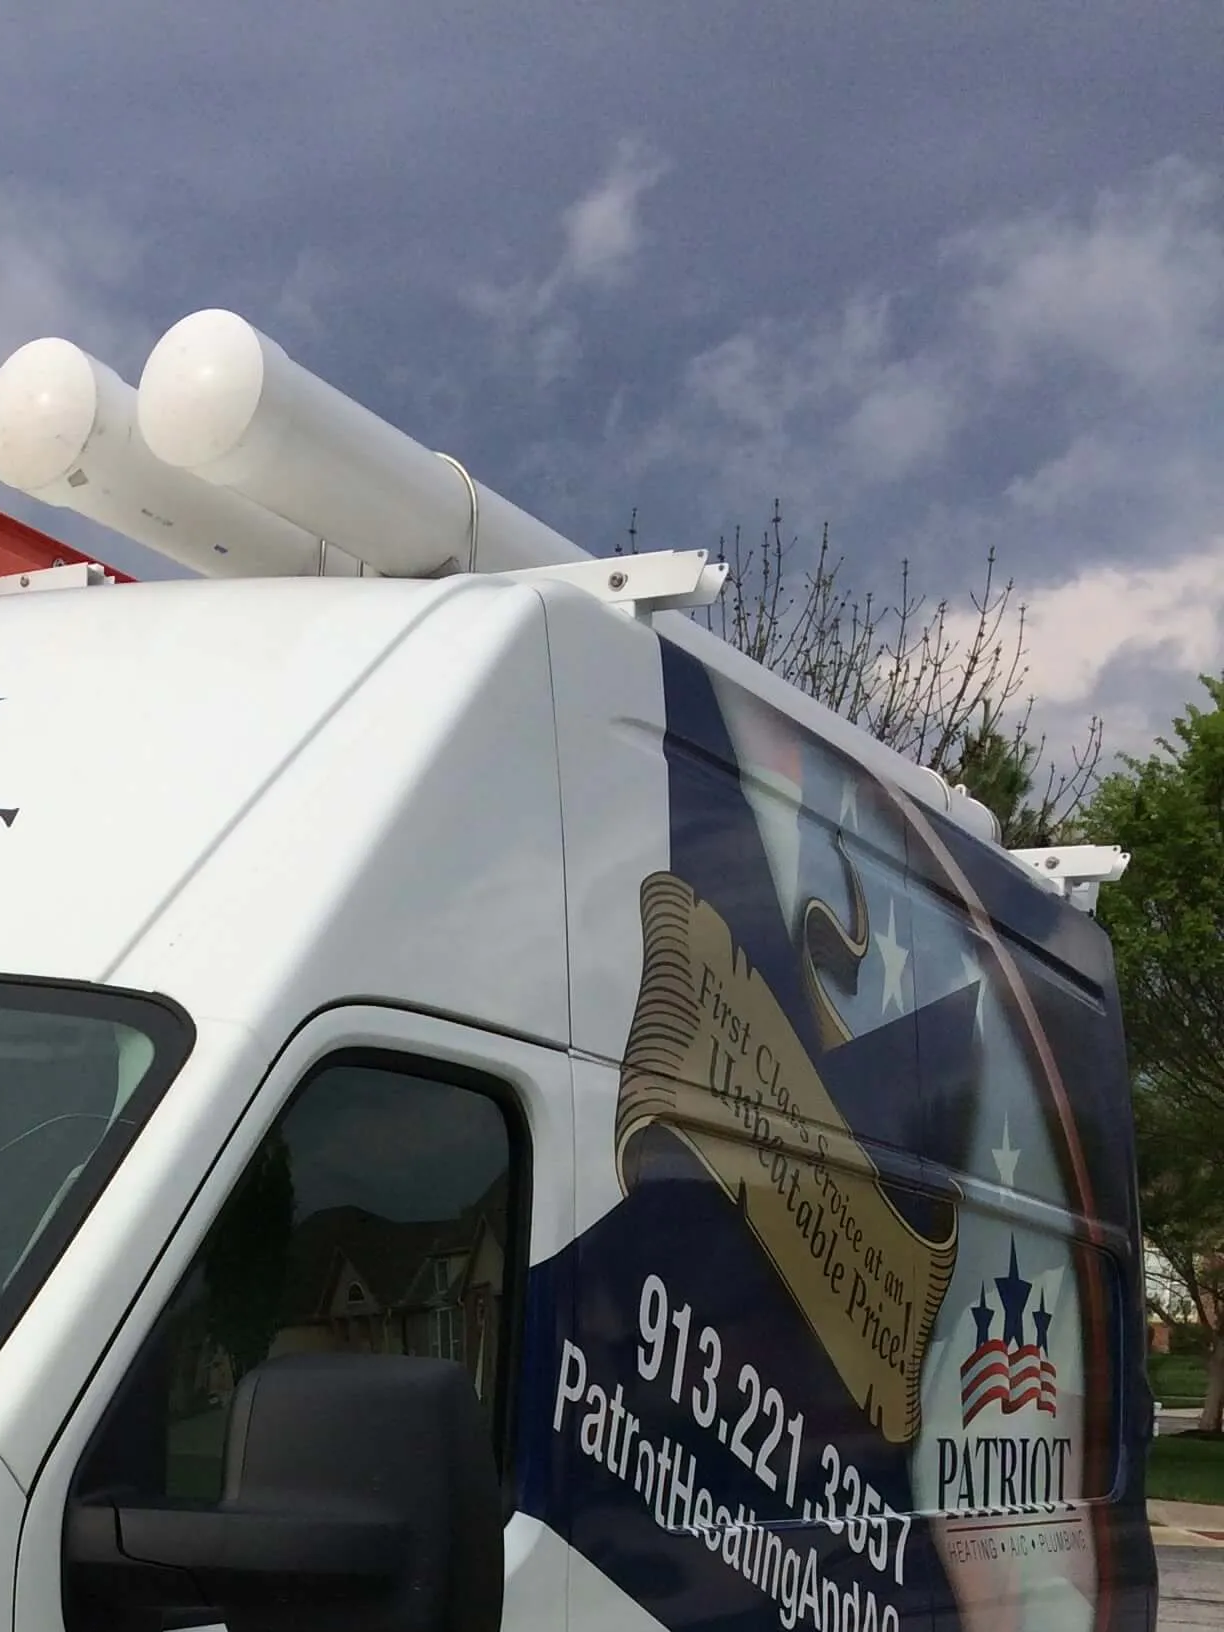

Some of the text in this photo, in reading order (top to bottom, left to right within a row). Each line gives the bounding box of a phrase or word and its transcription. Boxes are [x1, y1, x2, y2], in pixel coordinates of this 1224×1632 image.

[699, 962, 904, 1306] First Class Service at an
[709, 1034, 913, 1376] Unbeatable Price!
[937, 1436, 1076, 1520] PATRIOT
[948, 1539, 998, 1563] HEATING
[1038, 1529, 1088, 1553] PLUMBING
